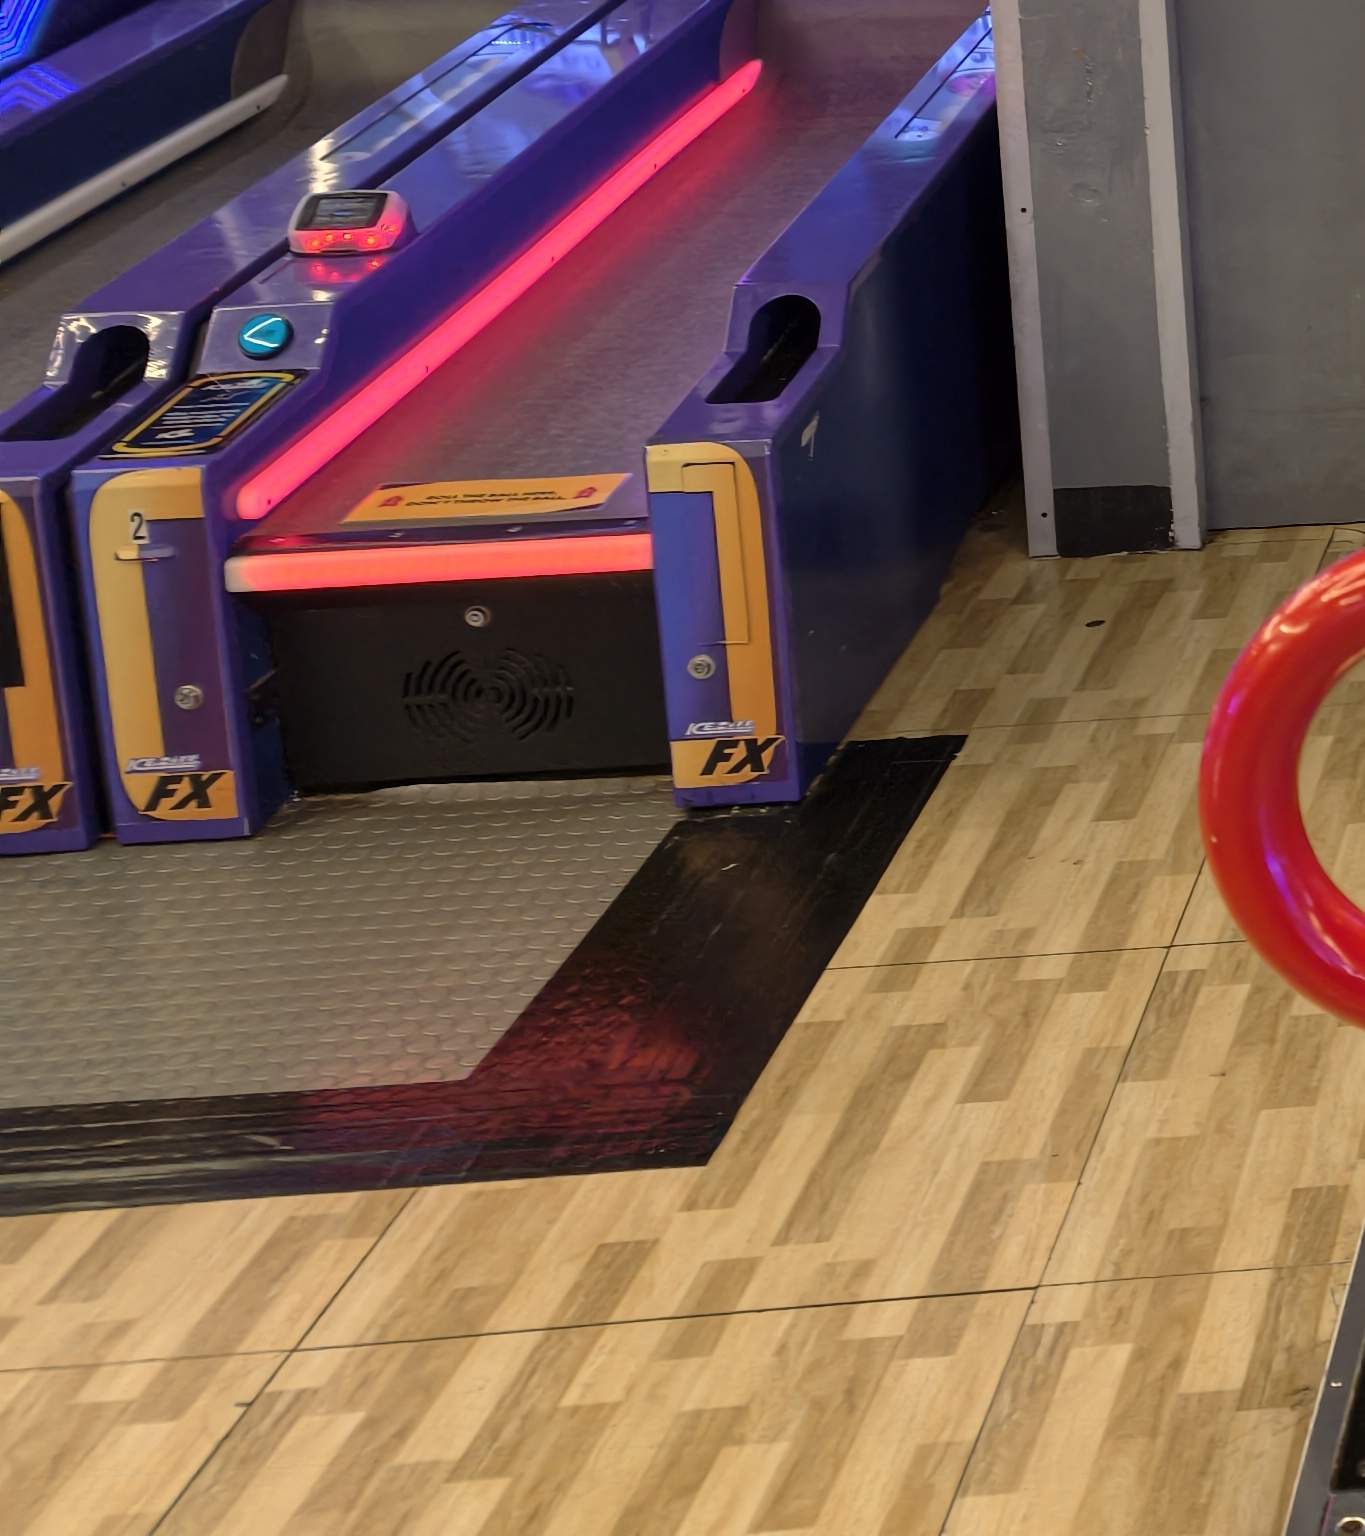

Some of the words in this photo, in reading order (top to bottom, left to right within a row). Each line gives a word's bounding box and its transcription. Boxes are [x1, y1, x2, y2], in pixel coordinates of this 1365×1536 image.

[129, 512, 146, 542] 2
[699, 736, 782, 776] FX
[0, 783, 70, 822] FX
[143, 771, 228, 813] FX
